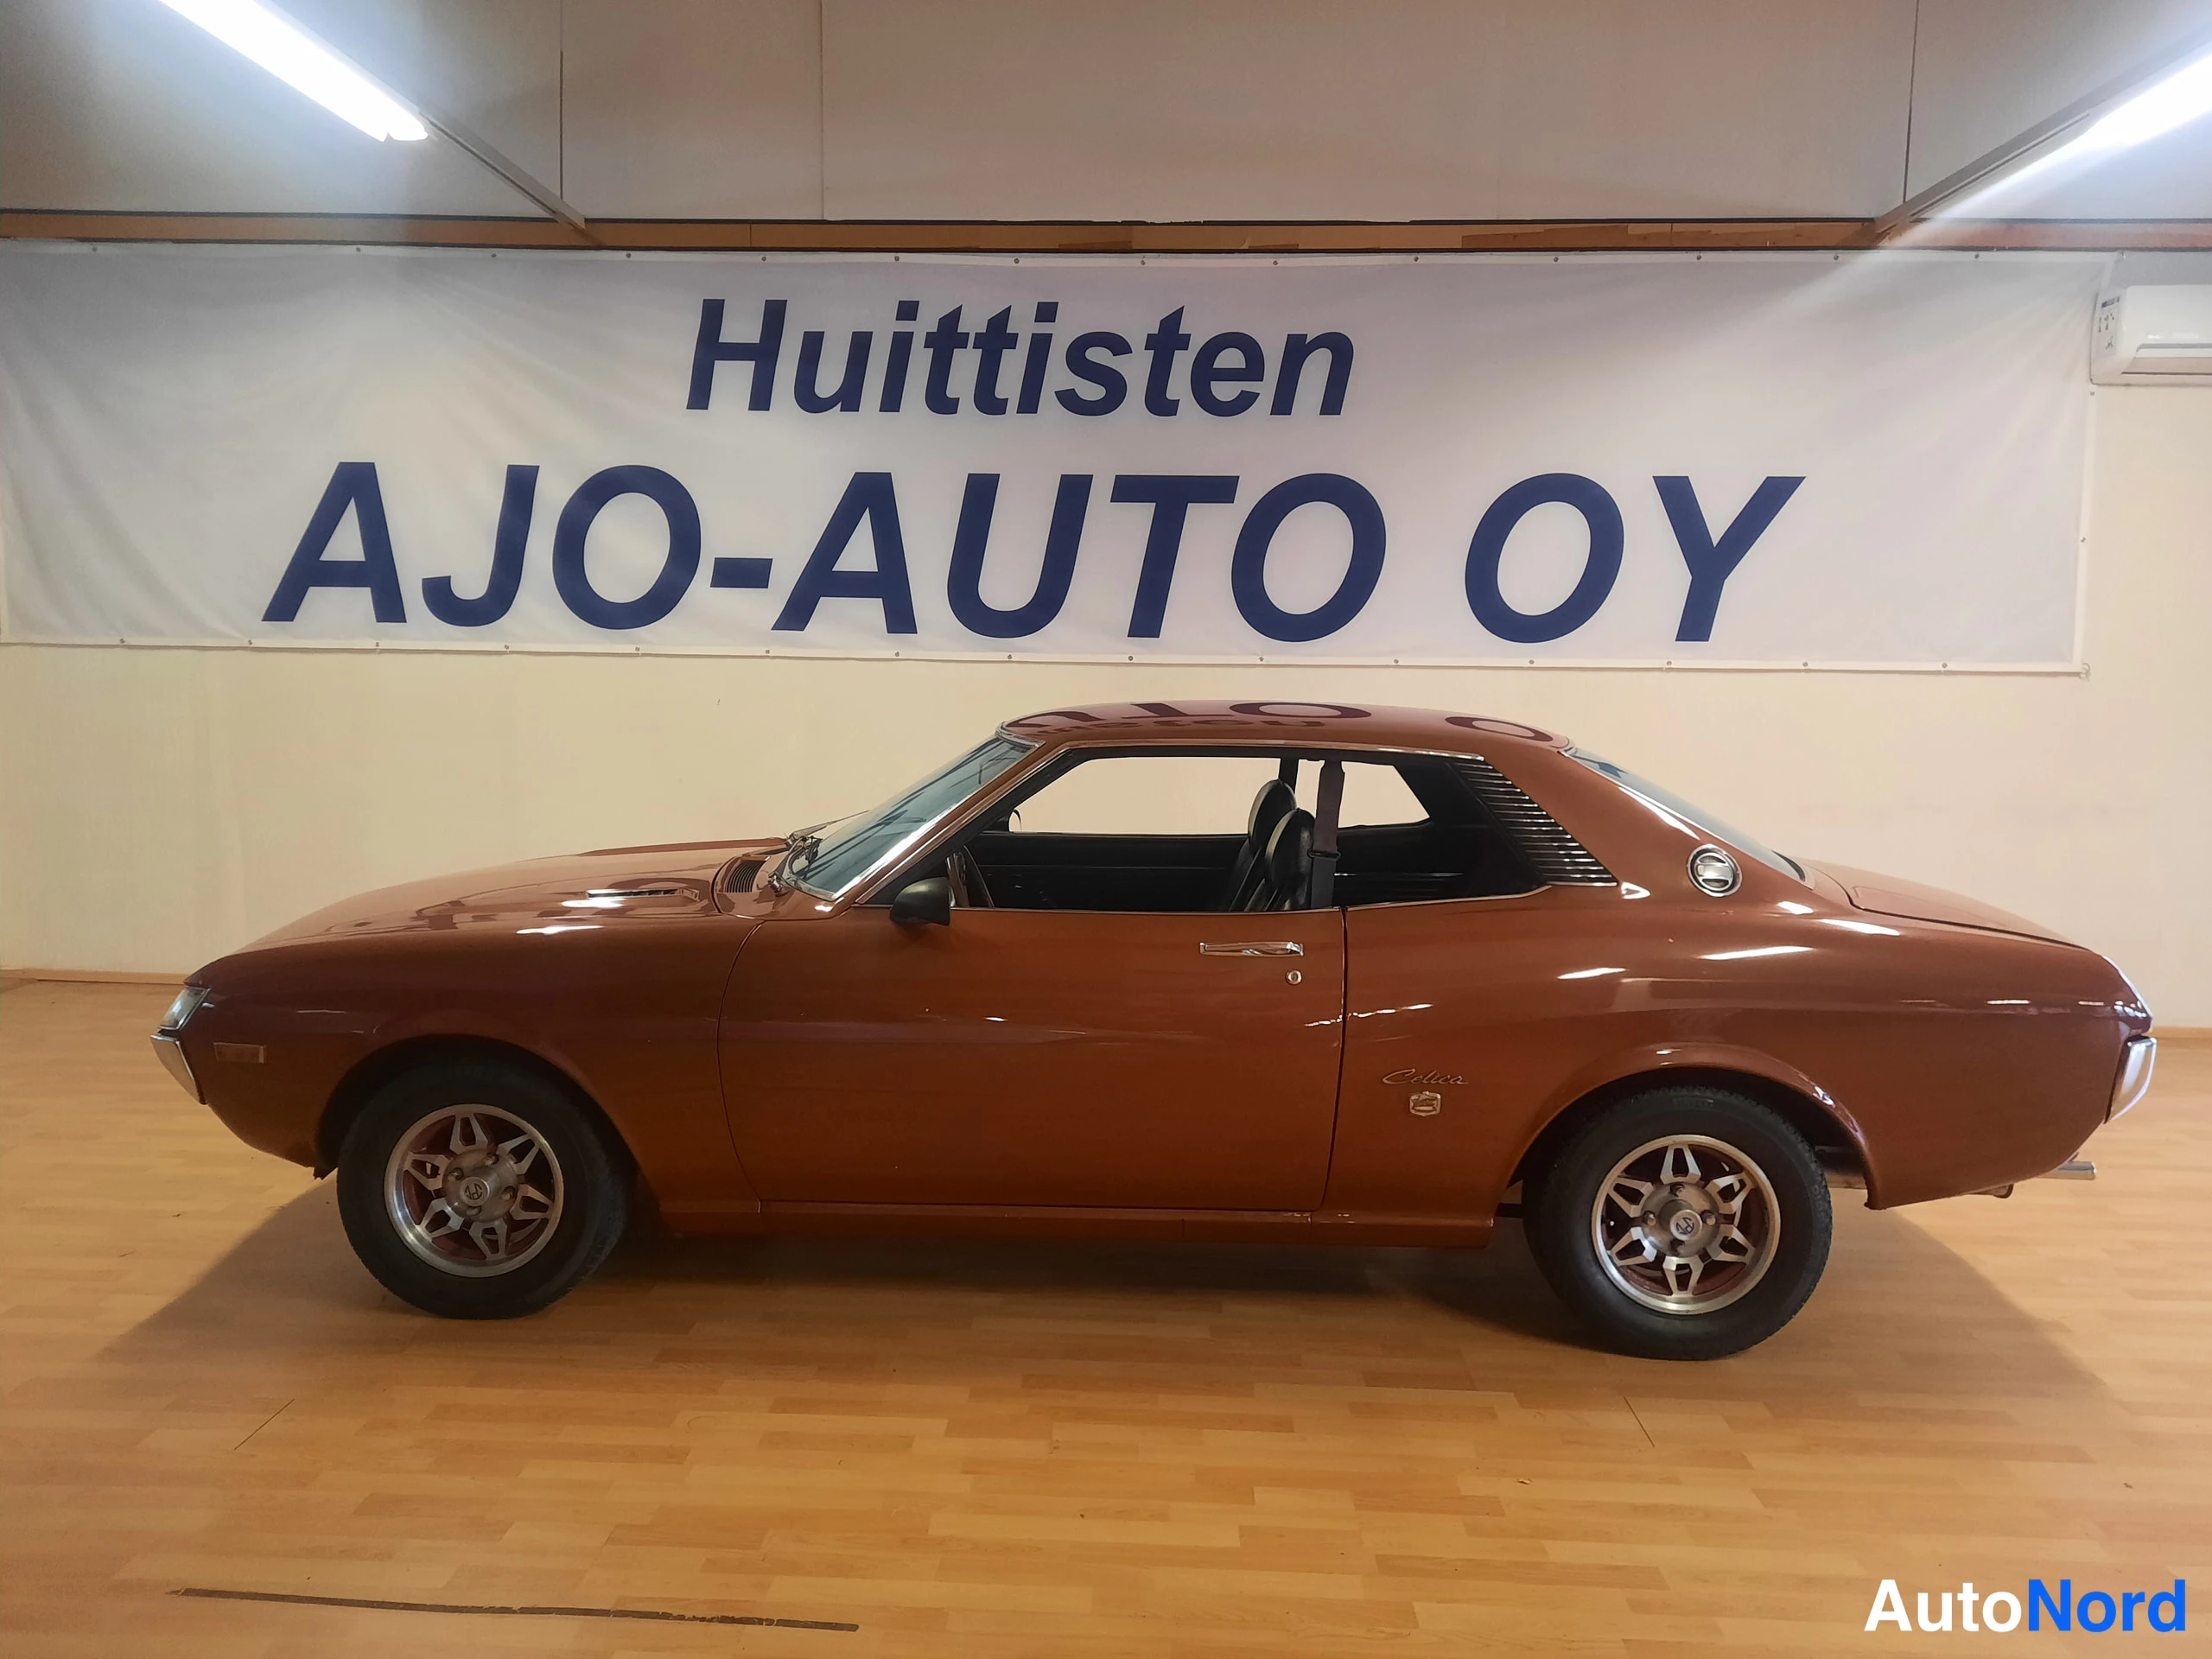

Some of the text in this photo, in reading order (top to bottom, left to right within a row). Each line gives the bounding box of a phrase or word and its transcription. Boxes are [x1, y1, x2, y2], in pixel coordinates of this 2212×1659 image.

[688, 300, 1354, 417] Huittisten
[264, 461, 1804, 644] AJO-AUTO OY
[1382, 1068, 1469, 1085] Celica
